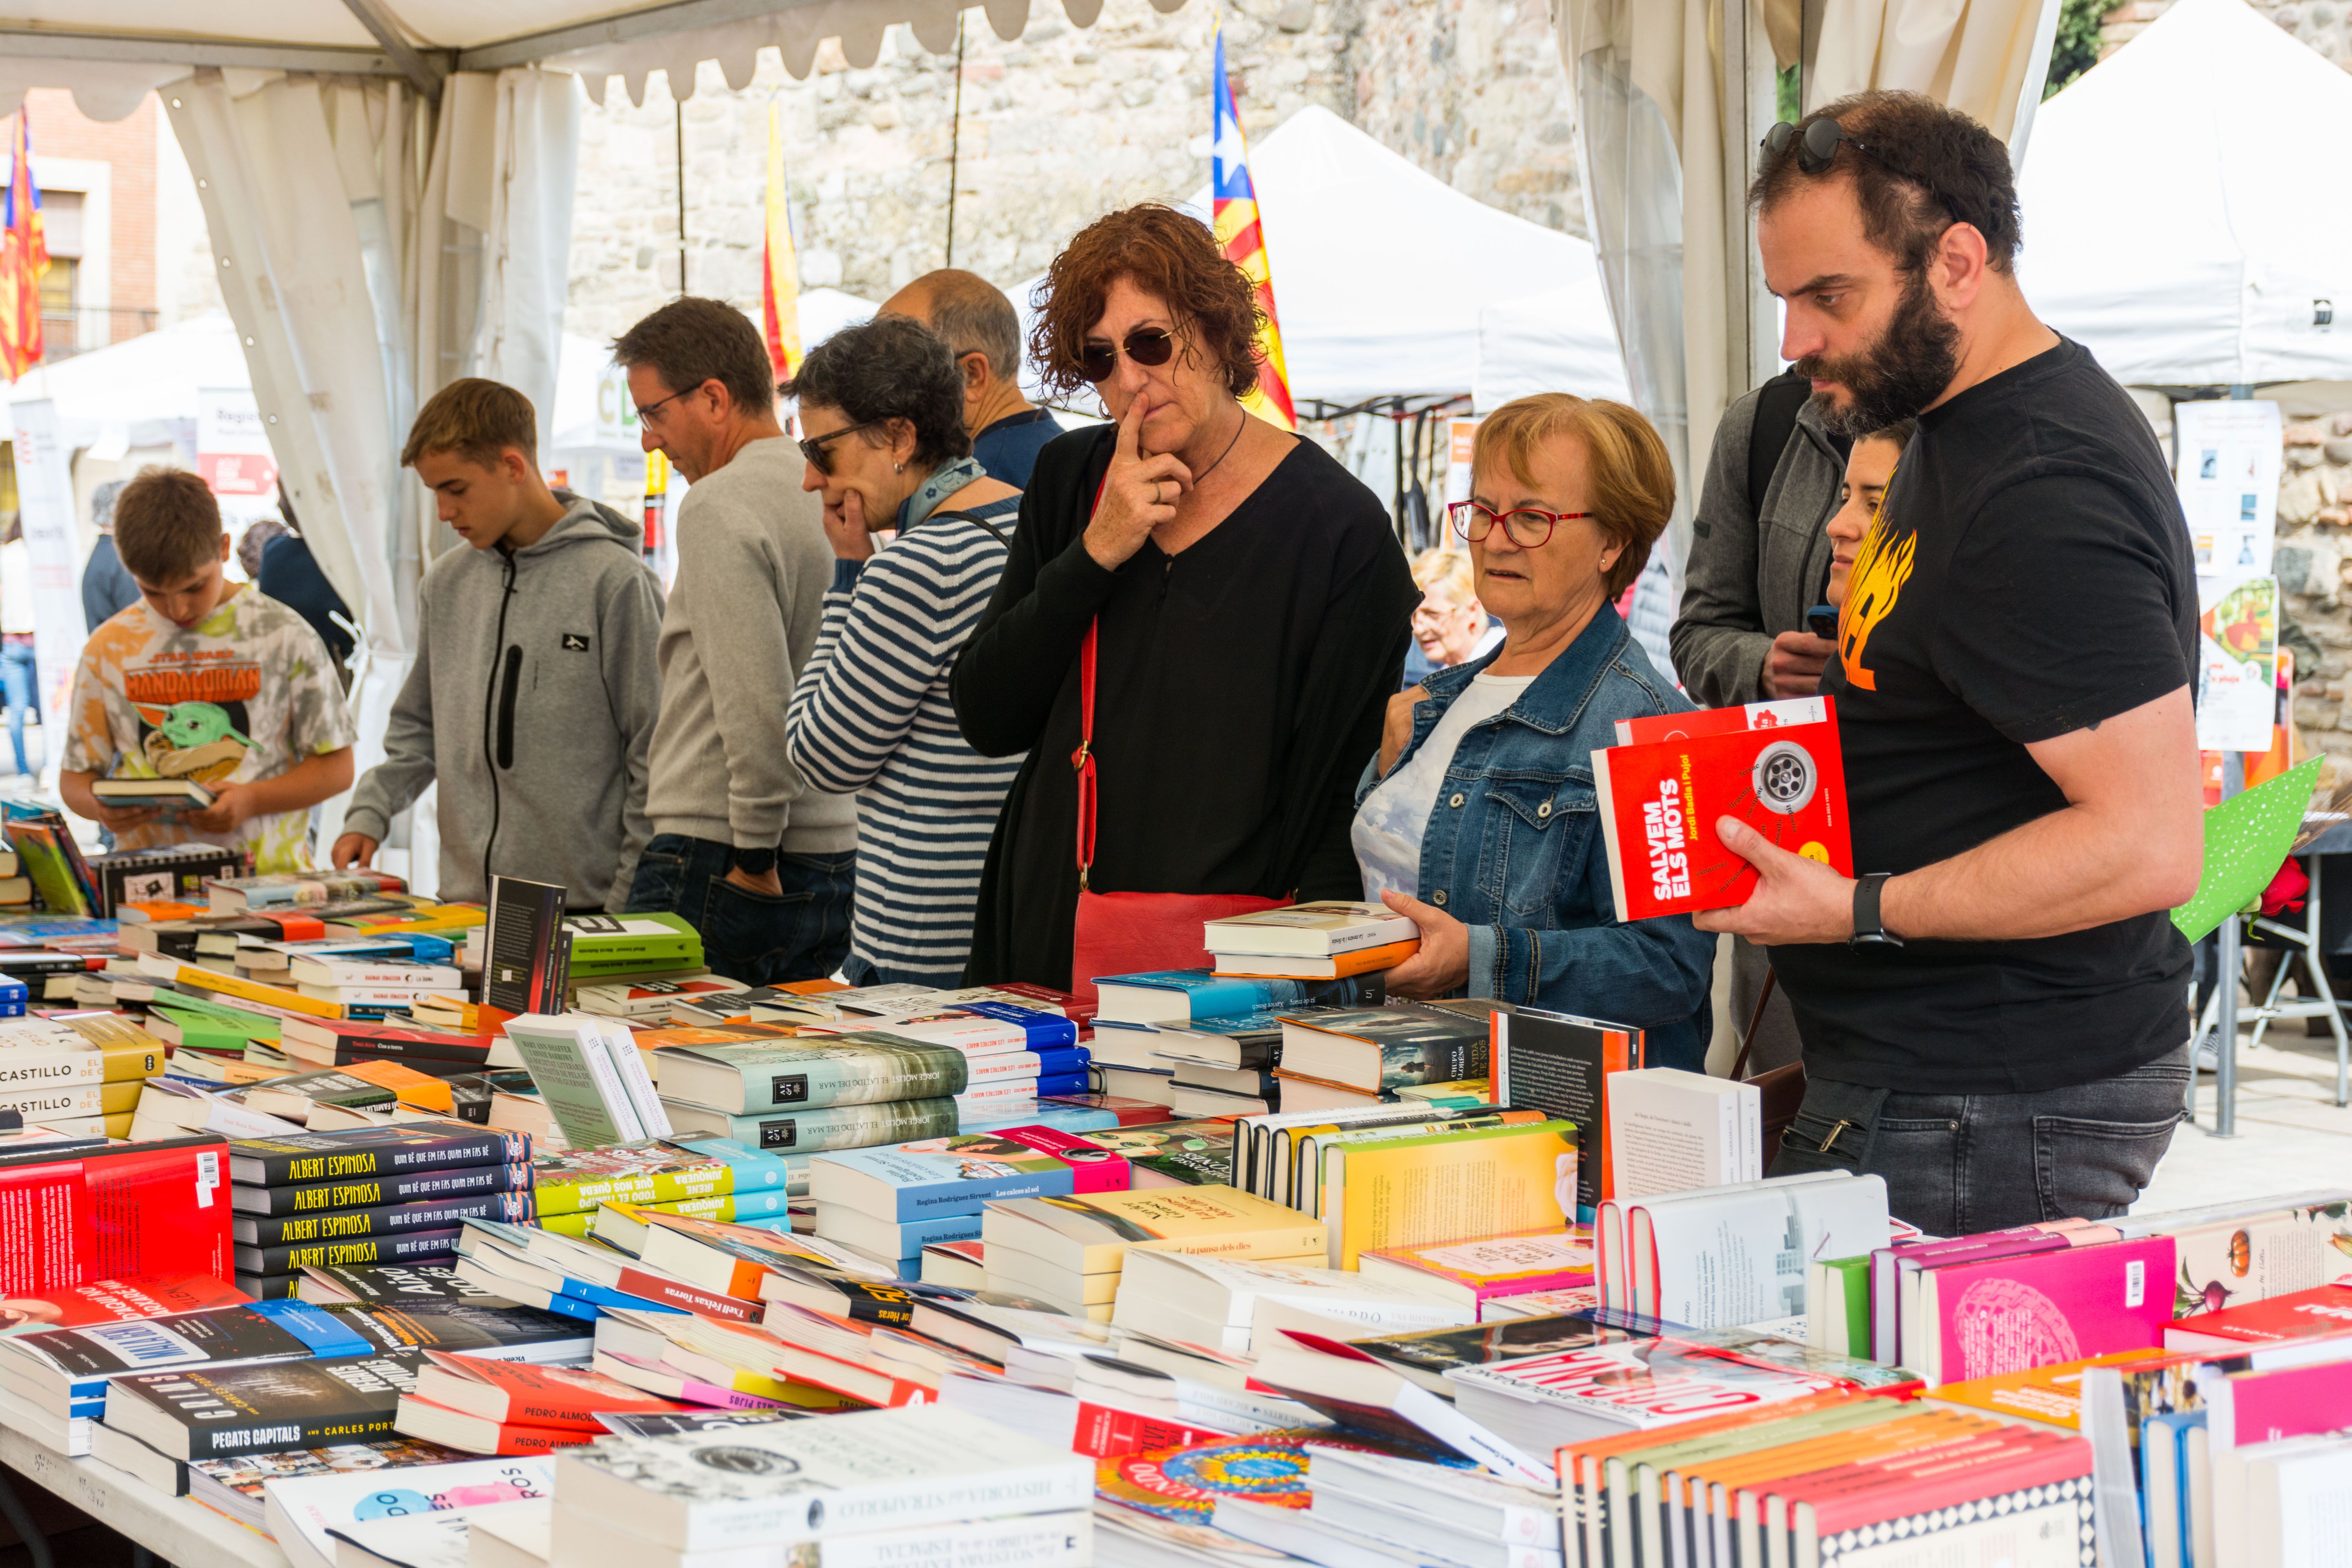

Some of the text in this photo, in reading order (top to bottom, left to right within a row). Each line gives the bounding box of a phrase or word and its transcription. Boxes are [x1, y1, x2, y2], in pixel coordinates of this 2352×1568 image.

[125, 667, 260, 703] MANDALORIAN
[1680, 755, 1698, 840] Jordi Badia Pujol
[1786, 804, 1797, 833] ensopit
[1660, 778, 1690, 897] ELS MOTS
[1644, 802, 1671, 900] SALVEM
[549, 1044, 572, 1053] SHAFFER
[550, 1053, 573, 1061] BARROWS
[557, 1062, 586, 1071] LITERARIA
[919, 1071, 939, 1080] JORGE
[564, 1080, 590, 1088] GUERNSEY
[891, 1074, 917, 1083] MOLIST
[841, 1122, 868, 1131] LATIDO
[881, 1119, 907, 1127] MOLIST
[394, 1145, 489, 1165] QUIN BÉ QUE EM FAS QUAN EM FAS BÉ
[289, 1153, 376, 1179] ALBERT ESPINOSA
[399, 1174, 493, 1194] QUIN BÉ QUE EM FAS QUAN EM FAS BÉ
[674, 1171, 722, 1184] JUNQUERA
[579, 1178, 653, 1196] QUE NOS QUEDA
[686, 1183, 714, 1194] IRENE
[295, 1183, 380, 1210] ALBERT ESPINOSA
[618, 1190, 656, 1203] TODO EL
[677, 1198, 725, 1212] JUNQUERA
[939, 1196, 968, 1205] Rodríguez
[390, 1215, 402, 1225] QUIN
[403, 1213, 410, 1225] BÉ
[412, 1213, 422, 1224] QUE
[424, 1212, 432, 1222] EM
[433, 1211, 442, 1221] FAS
[445, 1209, 458, 1221] QUAN
[470, 1207, 478, 1216] FAS
[480, 1205, 486, 1216] BÉ
[283, 1214, 370, 1241] ALBERT ESPINOSA
[943, 1233, 972, 1241] Rodríguez
[289, 1242, 377, 1269] ALBERT ESPINOSA
[396, 1240, 449, 1254] QUIN BÉ QUE EM FAS
[1197, 1245, 1218, 1255] pausa
[367, 1268, 446, 1295] Això
[88, 1296, 144, 1319] D'AQUÍ
[665, 1287, 744, 1318] Txell Feixas Torras
[878, 1310, 899, 1322] Heras
[370, 1325, 400, 1348] Vicenç
[372, 1312, 418, 1345] Vaticangate
[327, 1366, 393, 1392] PECATS
[525, 1407, 556, 1418] PEDRO
[212, 1429, 250, 1449] PECATS
[253, 1426, 300, 1446] CAPITALS
[325, 1425, 363, 1435] CARLES
[515, 1437, 546, 1448] PEDRO
